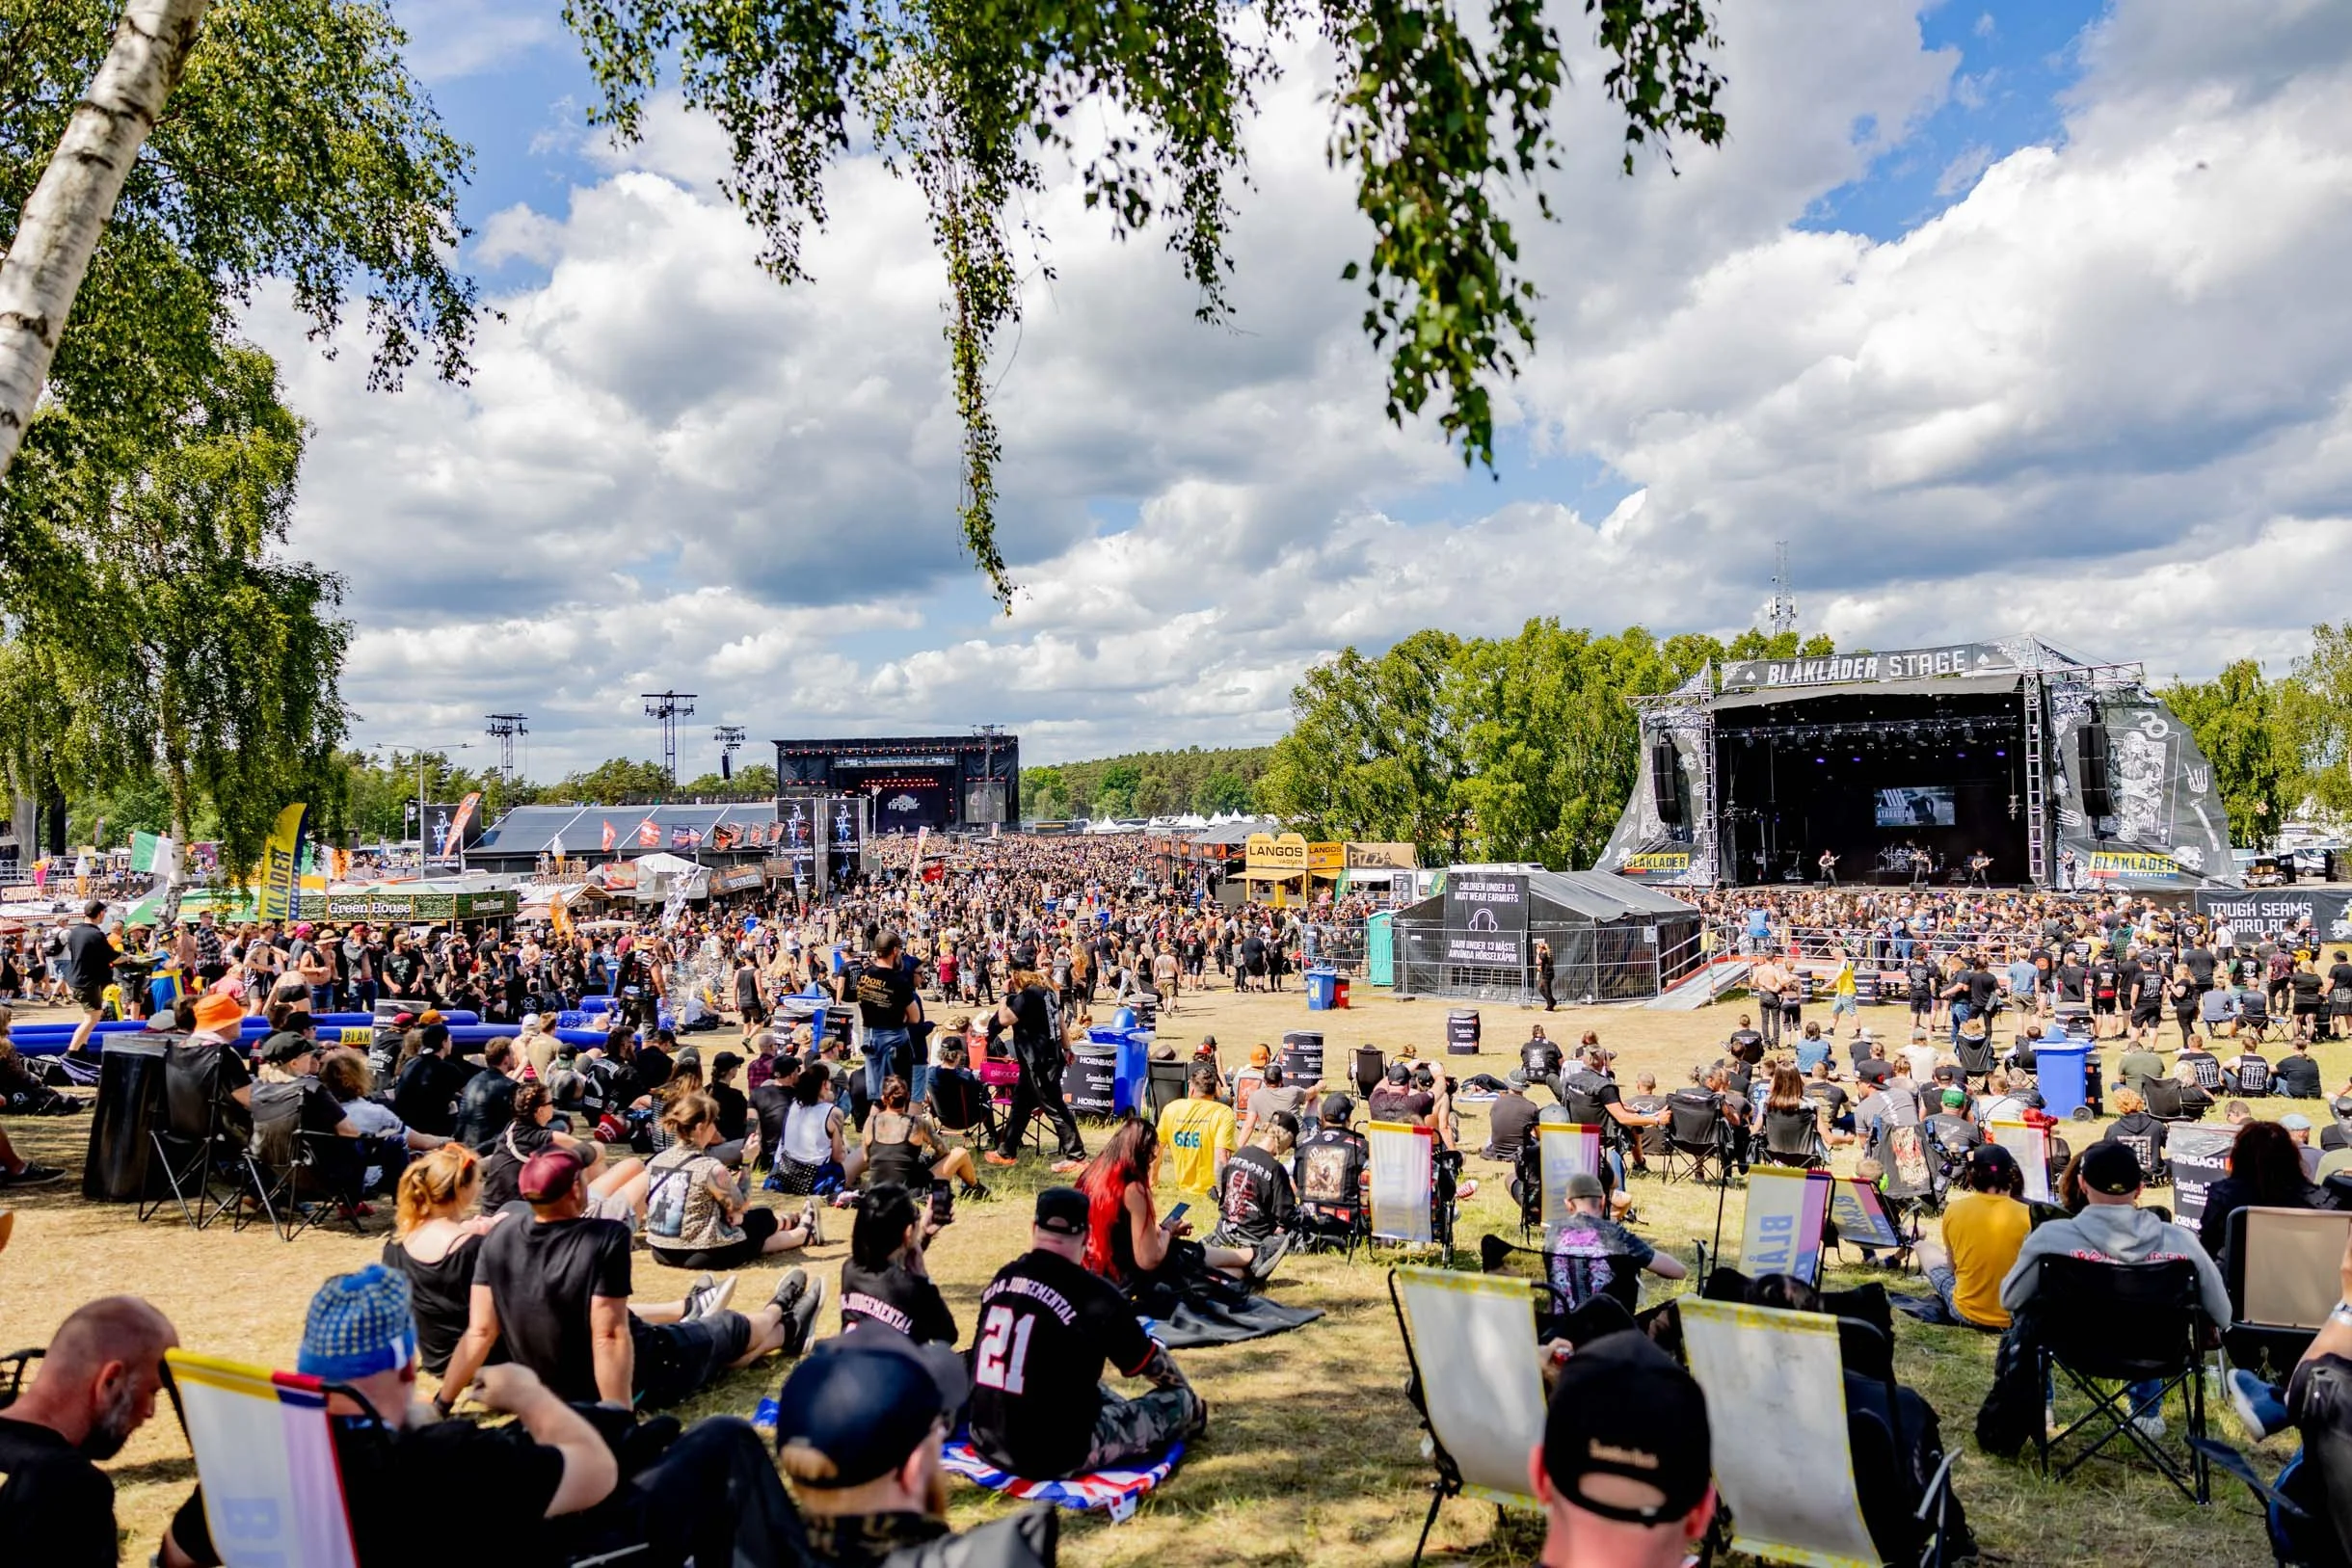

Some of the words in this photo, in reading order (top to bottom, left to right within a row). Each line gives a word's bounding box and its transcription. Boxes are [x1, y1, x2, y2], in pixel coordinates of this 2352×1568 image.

[1767, 655, 1879, 685] BLÅKLÄDER
[1888, 650, 1965, 677] STAGE
[1249, 846, 1303, 857] LANGOS
[1350, 851, 1393, 866] PIZZA
[1458, 882, 1484, 890] CHILDREN
[1486, 883, 1507, 891] UNDER
[1508, 884, 1515, 892] 13
[1469, 892, 1486, 901] WEAR
[1487, 892, 1519, 903] EARMUFFS
[329, 902, 369, 913] Green
[372, 902, 412, 914] House
[2207, 902, 2257, 917] TOUGH
[2261, 902, 2312, 917] SEAMS
[1487, 942, 1494, 950] 13
[1080, 1056, 1113, 1067] HORNBAC
[1078, 1097, 1110, 1106] HORNBAC
[2176, 1177, 2205, 1194] Sweden
[1005, 1276, 1078, 1326] JUDGEMENTAL
[846, 1292, 913, 1334] JUDGEMENTAL
[976, 1305, 1035, 1395] 21
